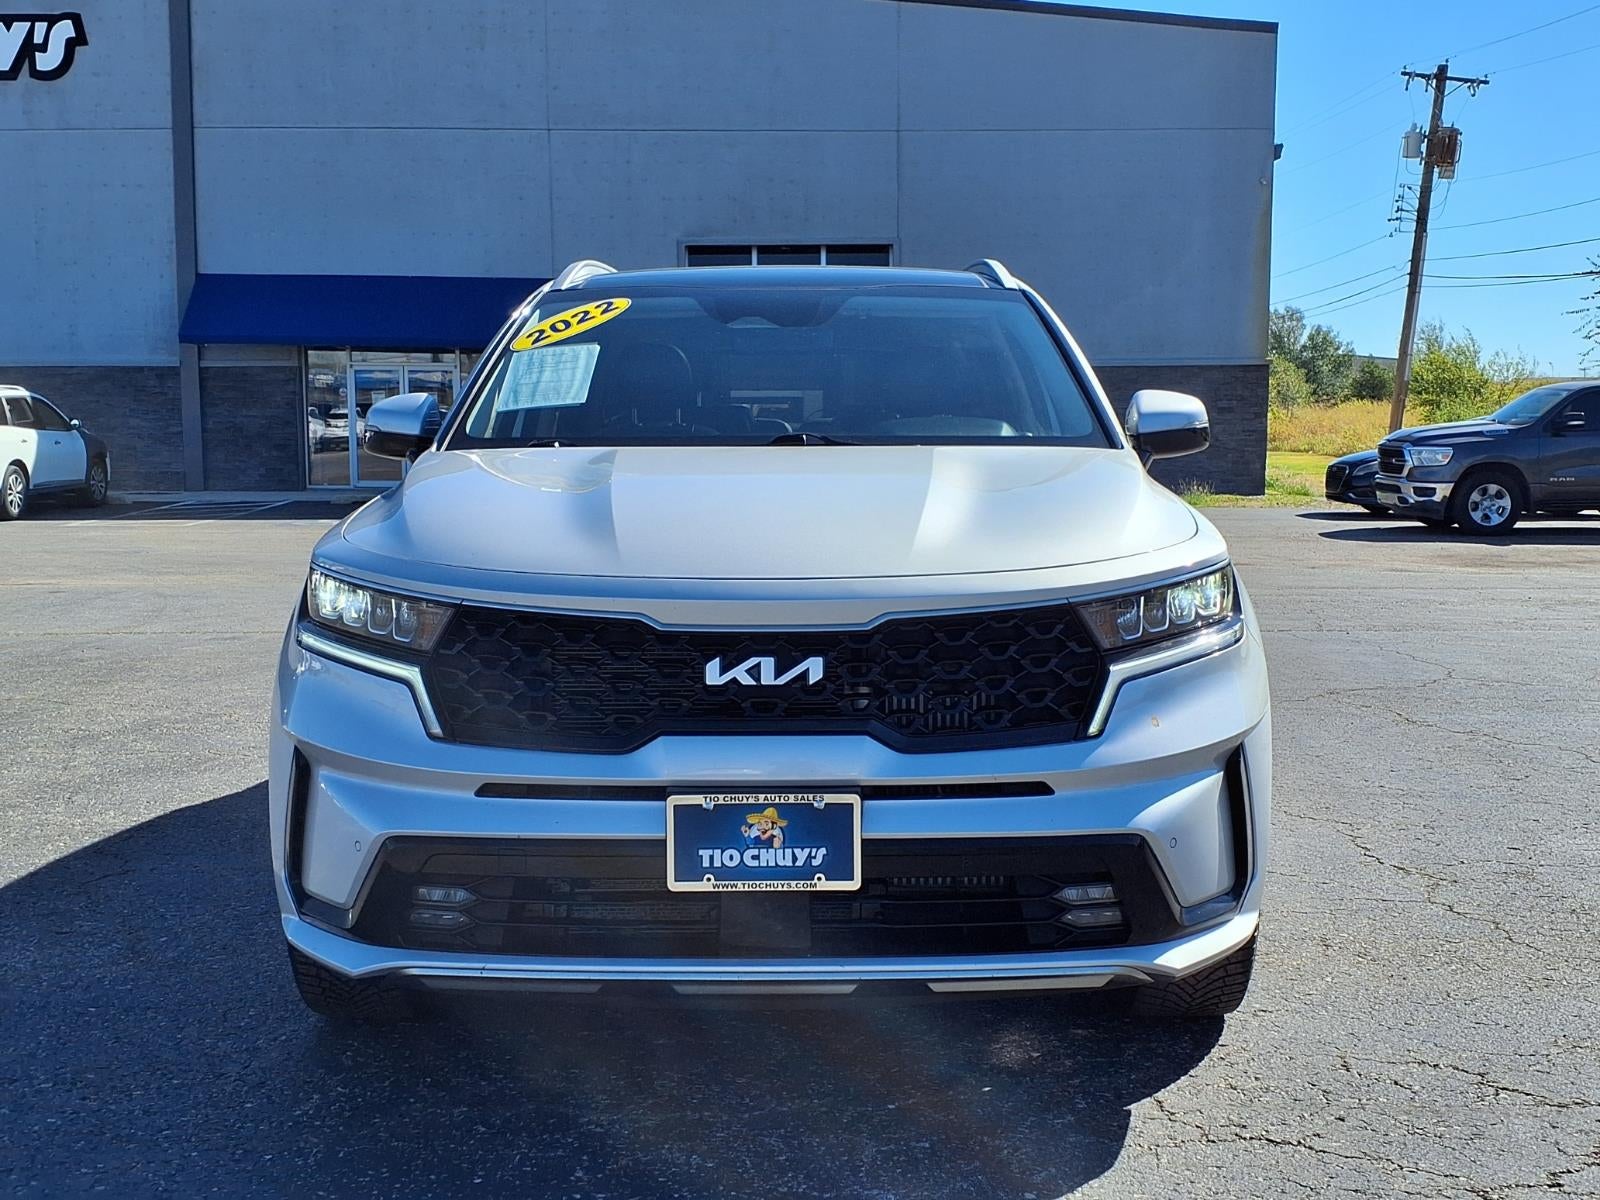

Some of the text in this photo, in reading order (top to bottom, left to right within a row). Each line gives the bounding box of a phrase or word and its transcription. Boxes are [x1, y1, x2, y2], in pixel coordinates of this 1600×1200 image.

[525, 301, 621, 346] 2022
[705, 656, 824, 686] KIA
[702, 794, 825, 803] TIO CHUY'S AUTO SALES
[698, 846, 828, 868] TIO CHUY'S
[711, 882, 819, 890] WWW.TIOCHUYS.COM
